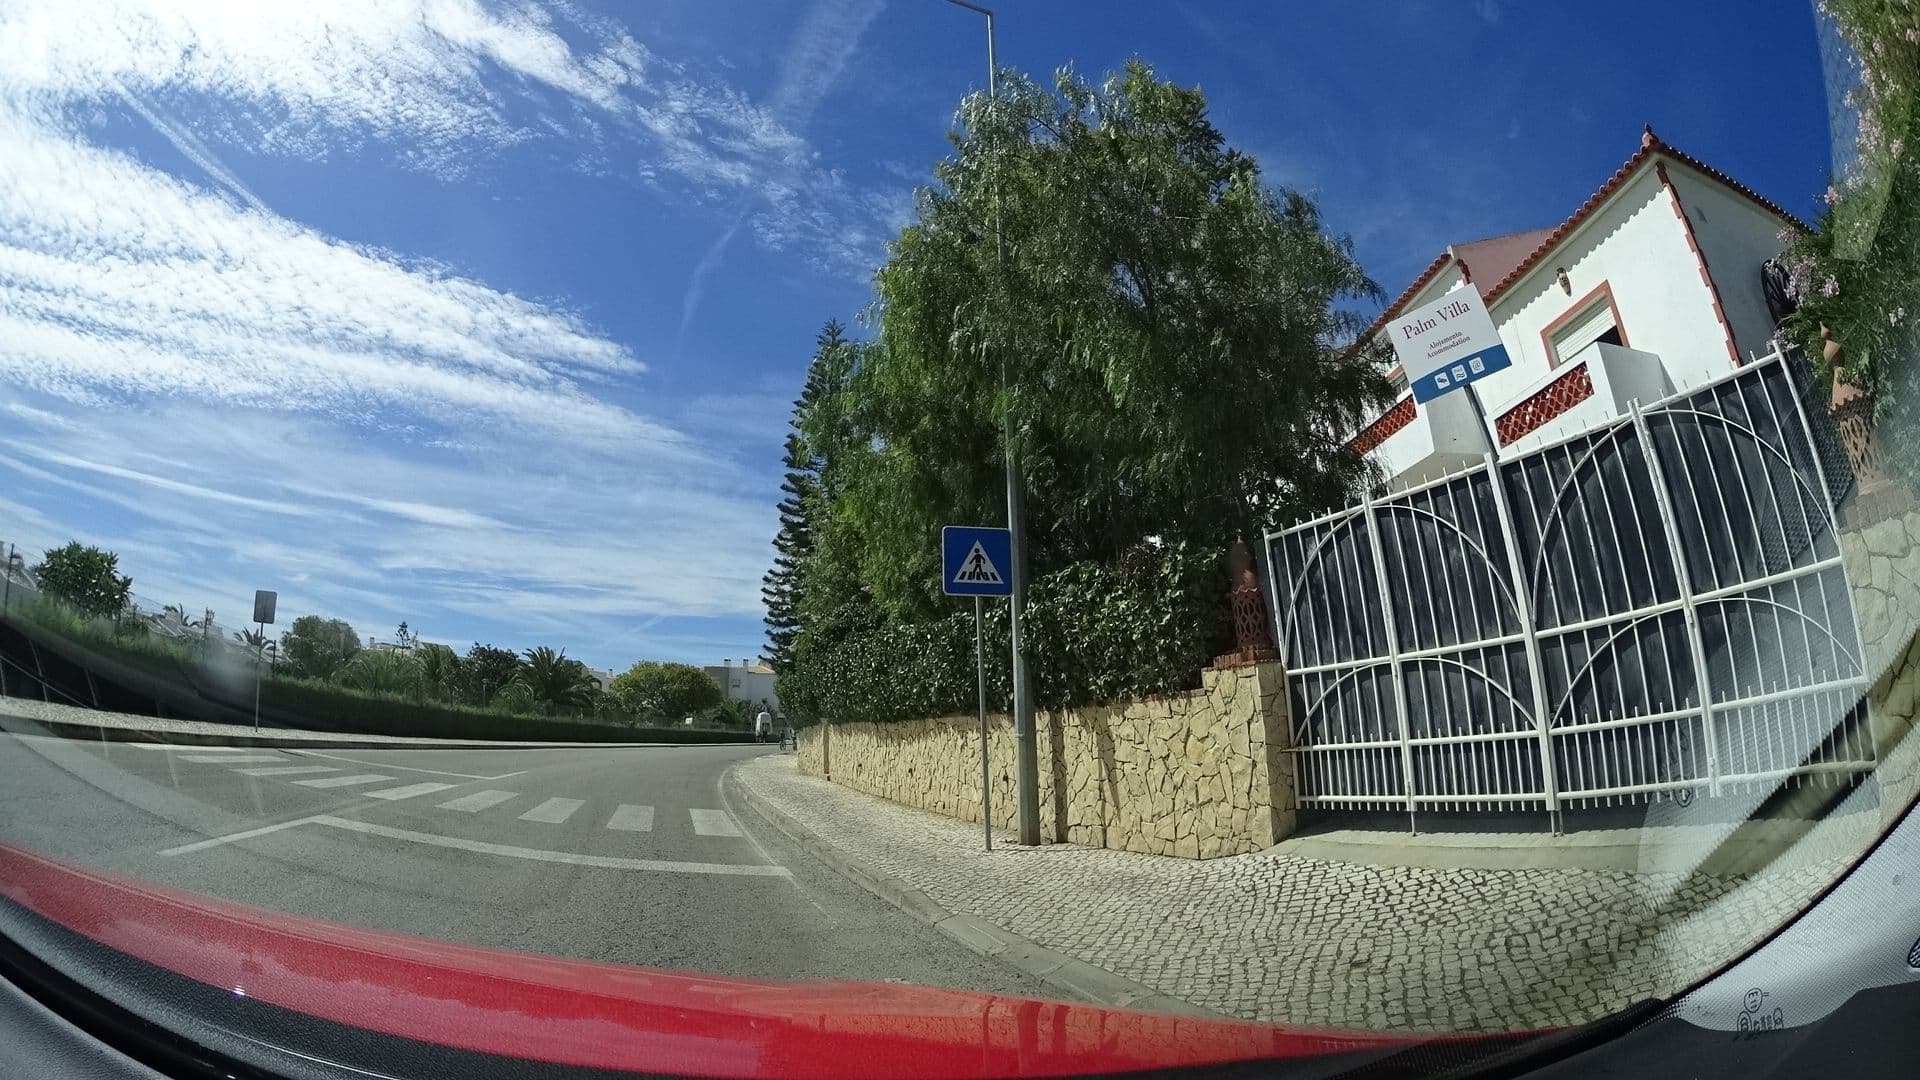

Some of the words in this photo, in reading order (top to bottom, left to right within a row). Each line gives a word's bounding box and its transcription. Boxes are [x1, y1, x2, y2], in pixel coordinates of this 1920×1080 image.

[1402, 318, 1437, 339] Palm
[1436, 301, 1471, 322] Villa
[1429, 331, 1463, 350] Alojamento
